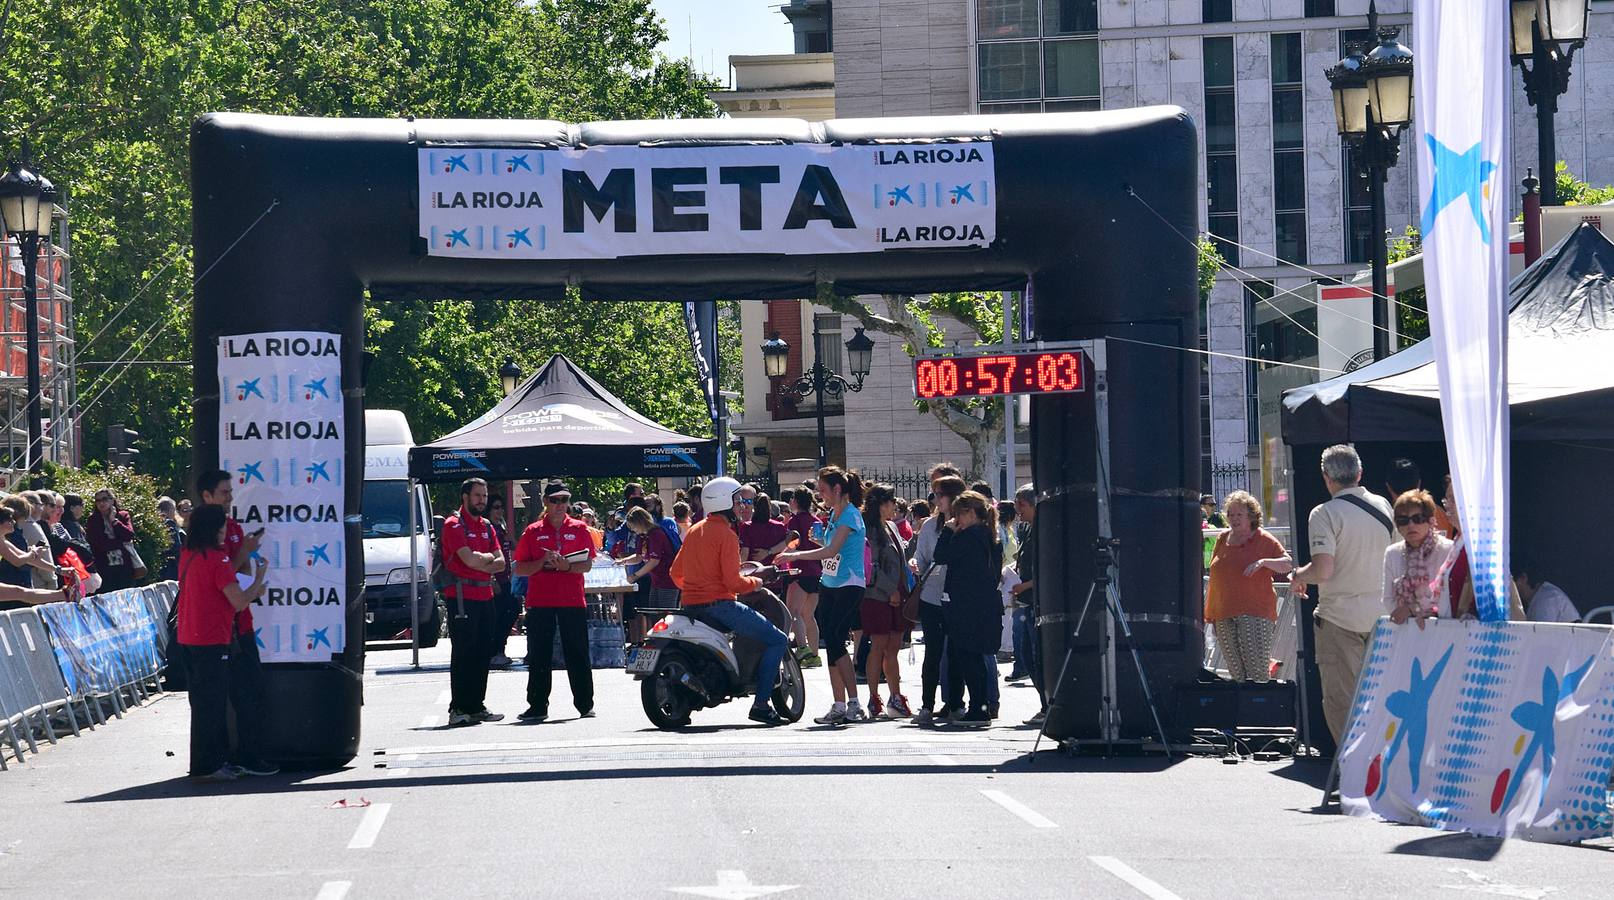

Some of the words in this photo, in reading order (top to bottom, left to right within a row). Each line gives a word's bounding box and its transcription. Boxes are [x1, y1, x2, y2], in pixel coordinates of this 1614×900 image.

[879, 150, 909, 165] LA
[913, 149, 984, 164] RIOJA
[437, 191, 469, 208] LA
[472, 191, 544, 208] RIOJA
[562, 164, 857, 233] META
[881, 227, 911, 242] LA
[915, 225, 985, 241] RIOJA
[229, 339, 260, 357] LA
[266, 338, 338, 356] RIOJA
[230, 422, 262, 440] LA
[267, 421, 339, 440] RIOJA
[432, 450, 487, 460] POWERADE
[643, 447, 697, 455] POWERADE
[232, 505, 262, 524] LA
[268, 504, 338, 523] RIOJA
[268, 587, 341, 606] RIOJA
